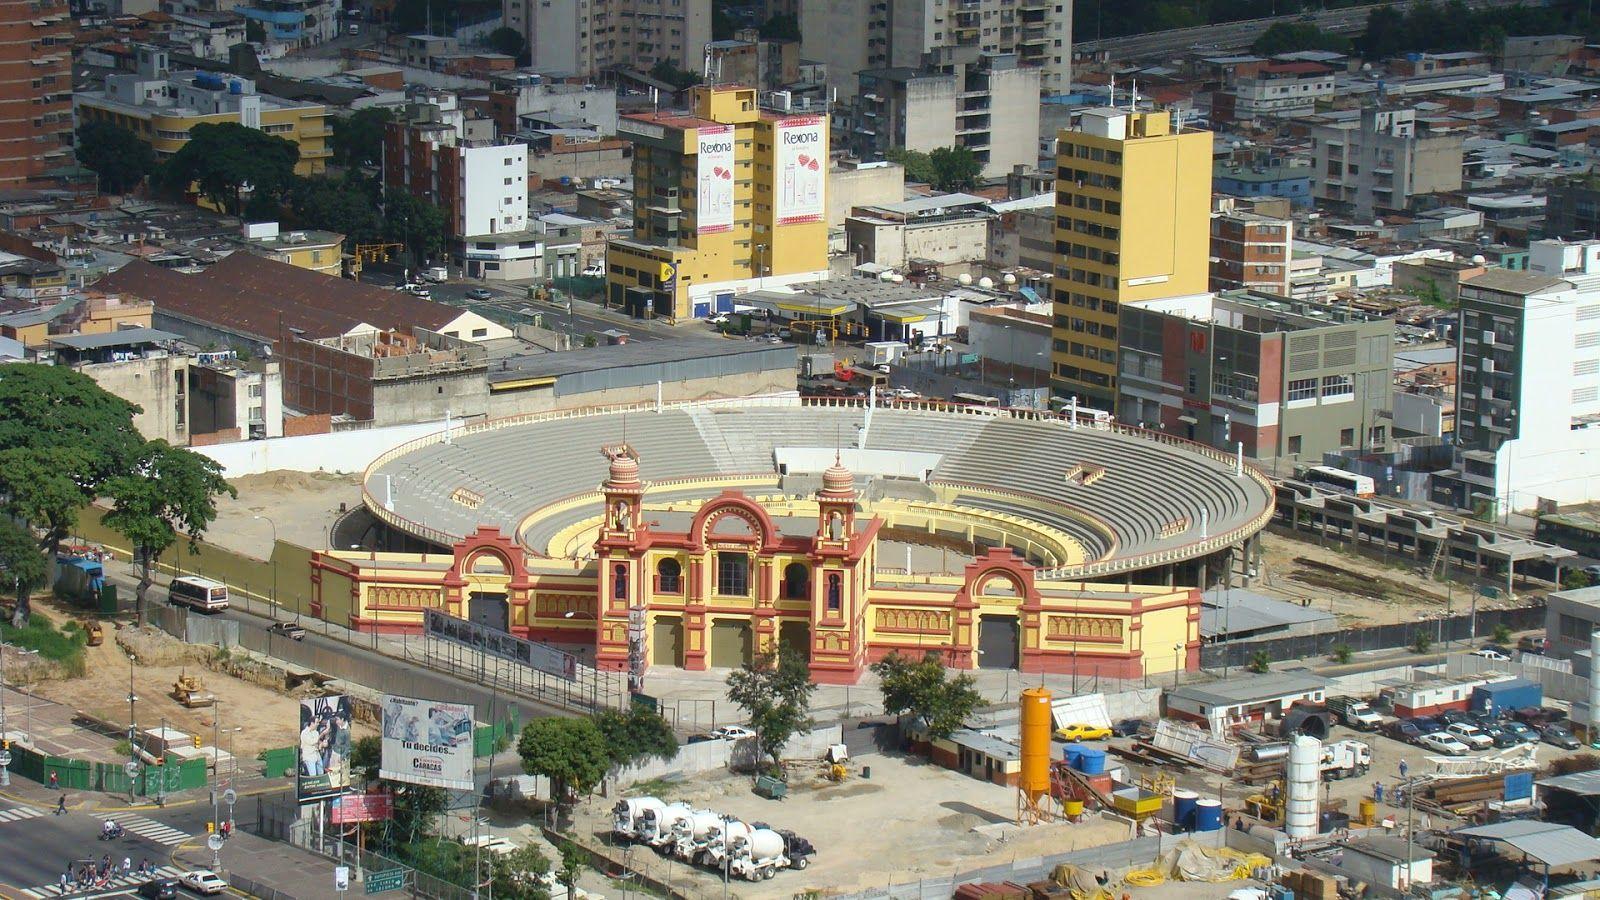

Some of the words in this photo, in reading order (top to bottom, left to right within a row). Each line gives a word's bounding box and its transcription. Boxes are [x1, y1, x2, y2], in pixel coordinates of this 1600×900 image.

[783, 131, 818, 144] Rexona
[700, 142, 732, 154] Rexona
[401, 740, 413, 750] Tu
